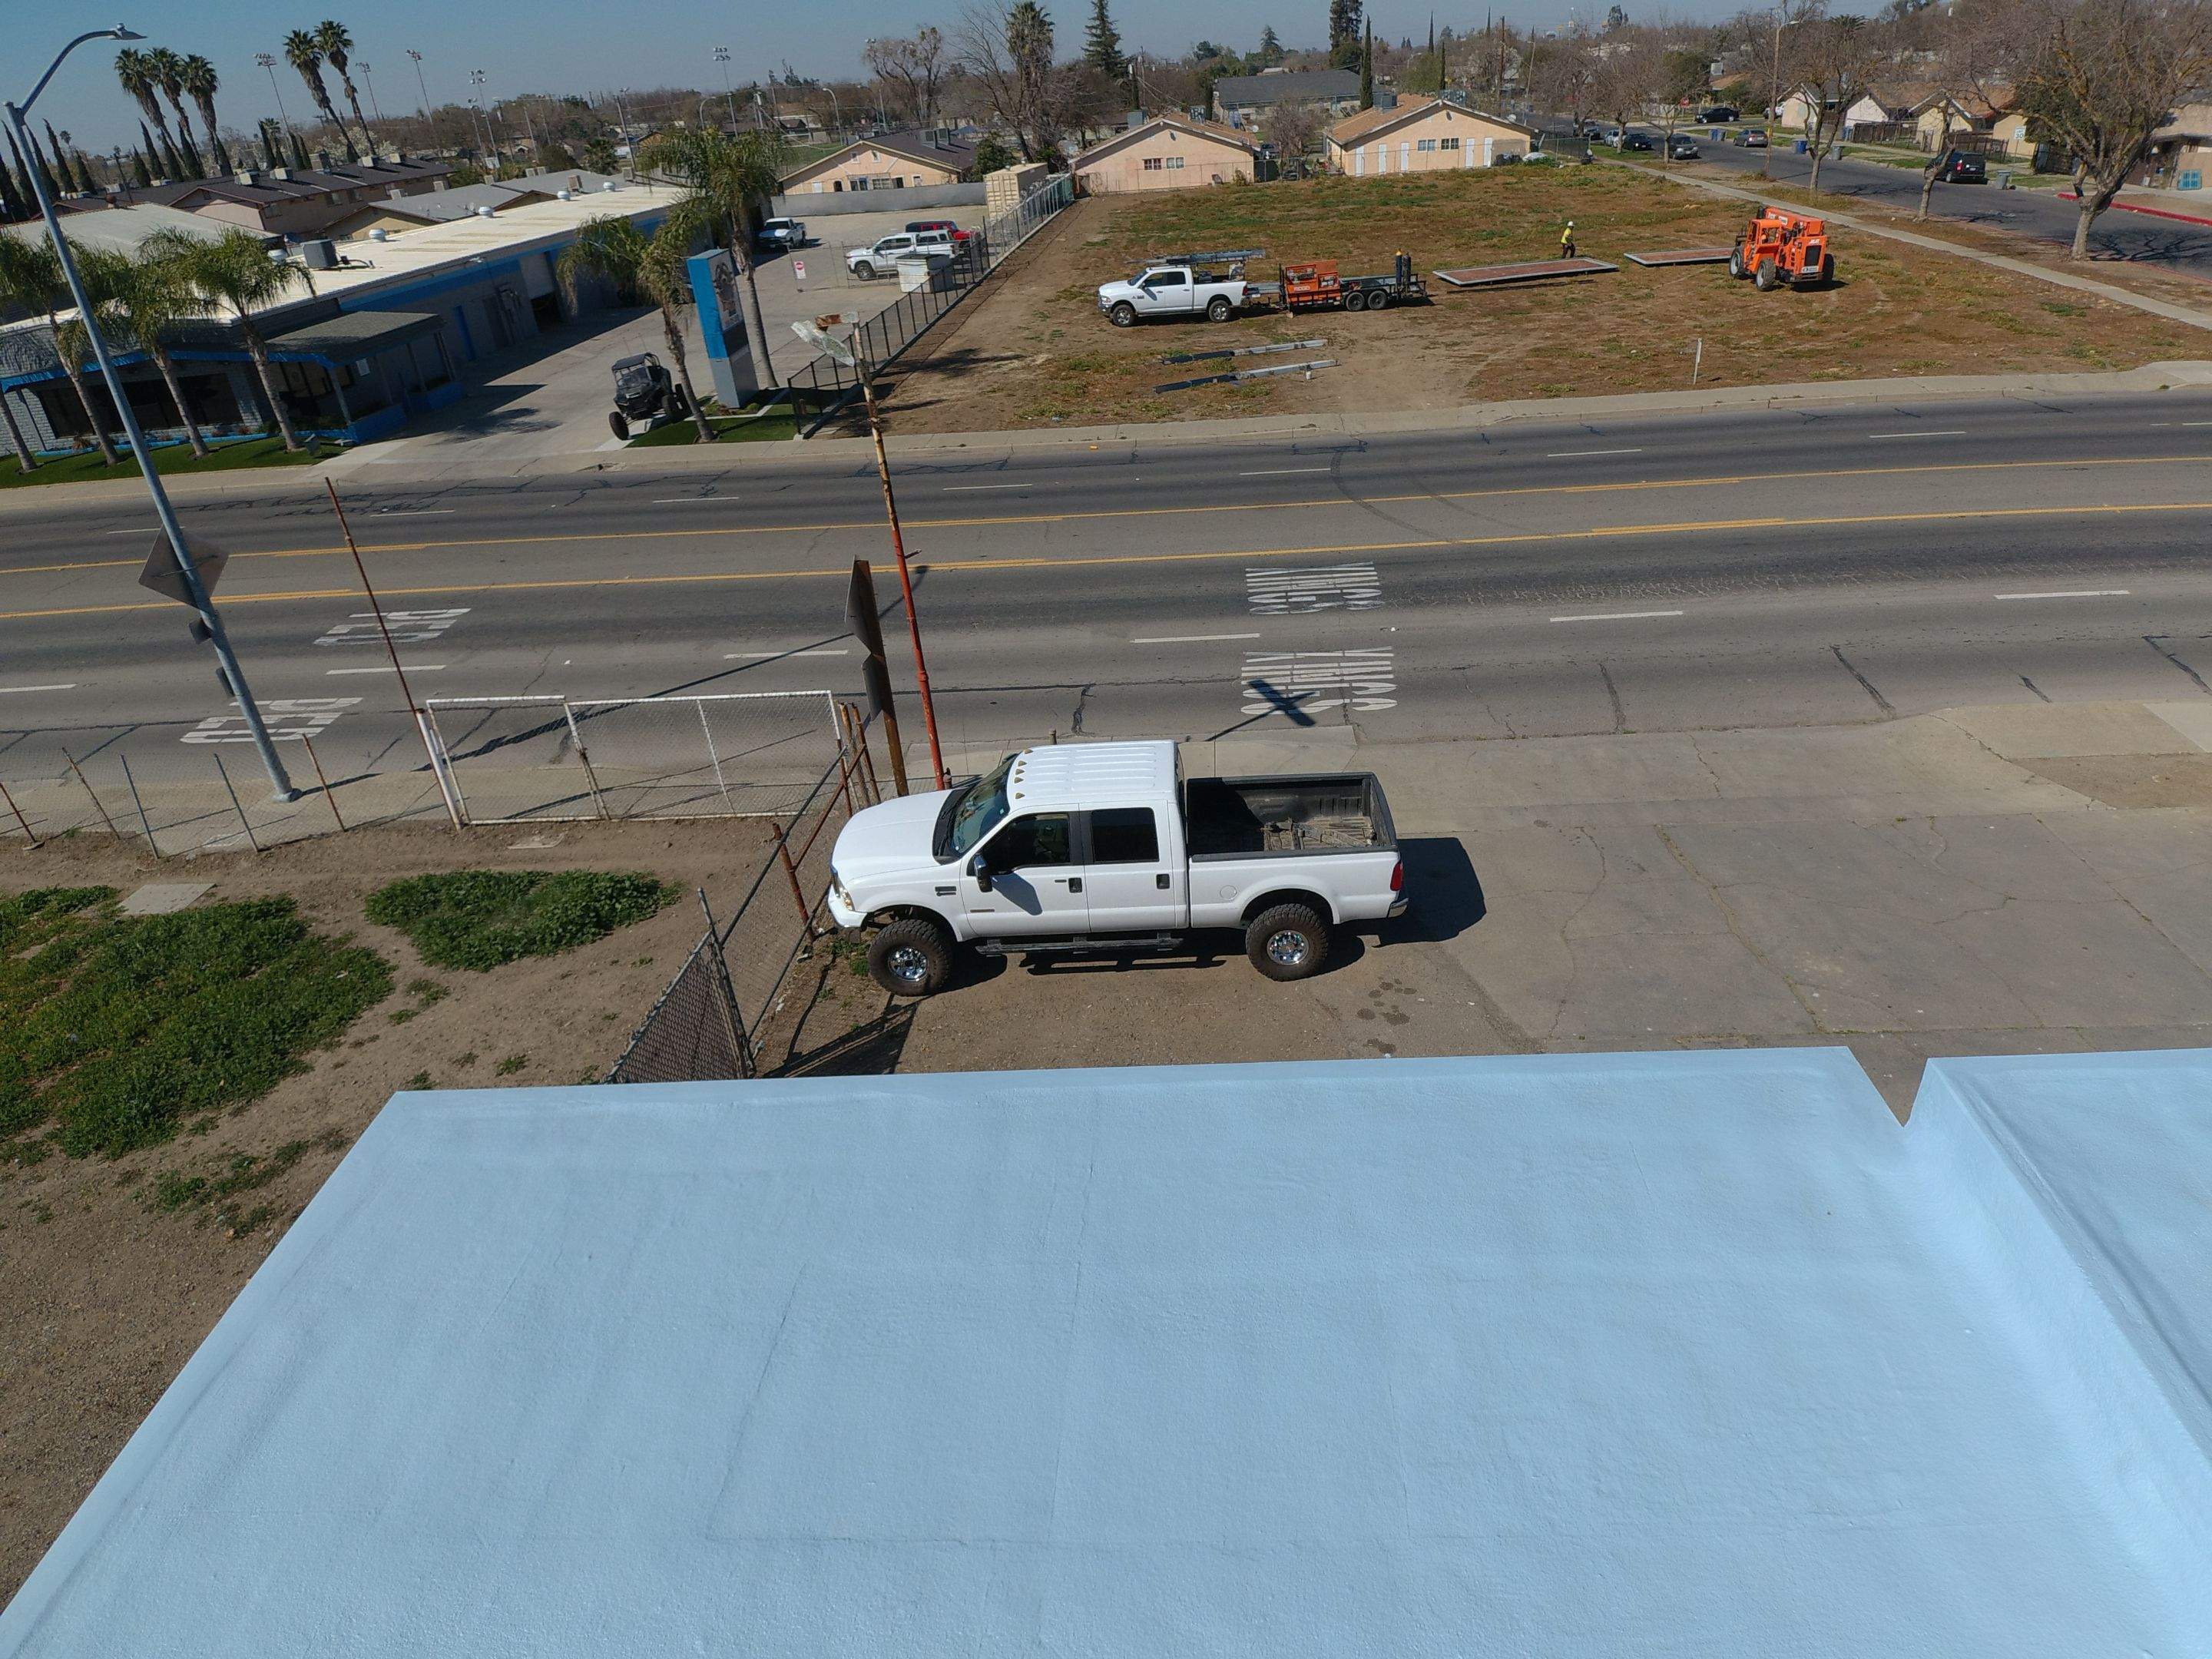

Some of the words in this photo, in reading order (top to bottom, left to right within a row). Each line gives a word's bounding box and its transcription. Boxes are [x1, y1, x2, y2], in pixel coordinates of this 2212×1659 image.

[1245, 561, 1384, 614] XINGS
[313, 608, 472, 647] PED
[1240, 646, 1398, 714] XINGS
[180, 697, 363, 743] PED
